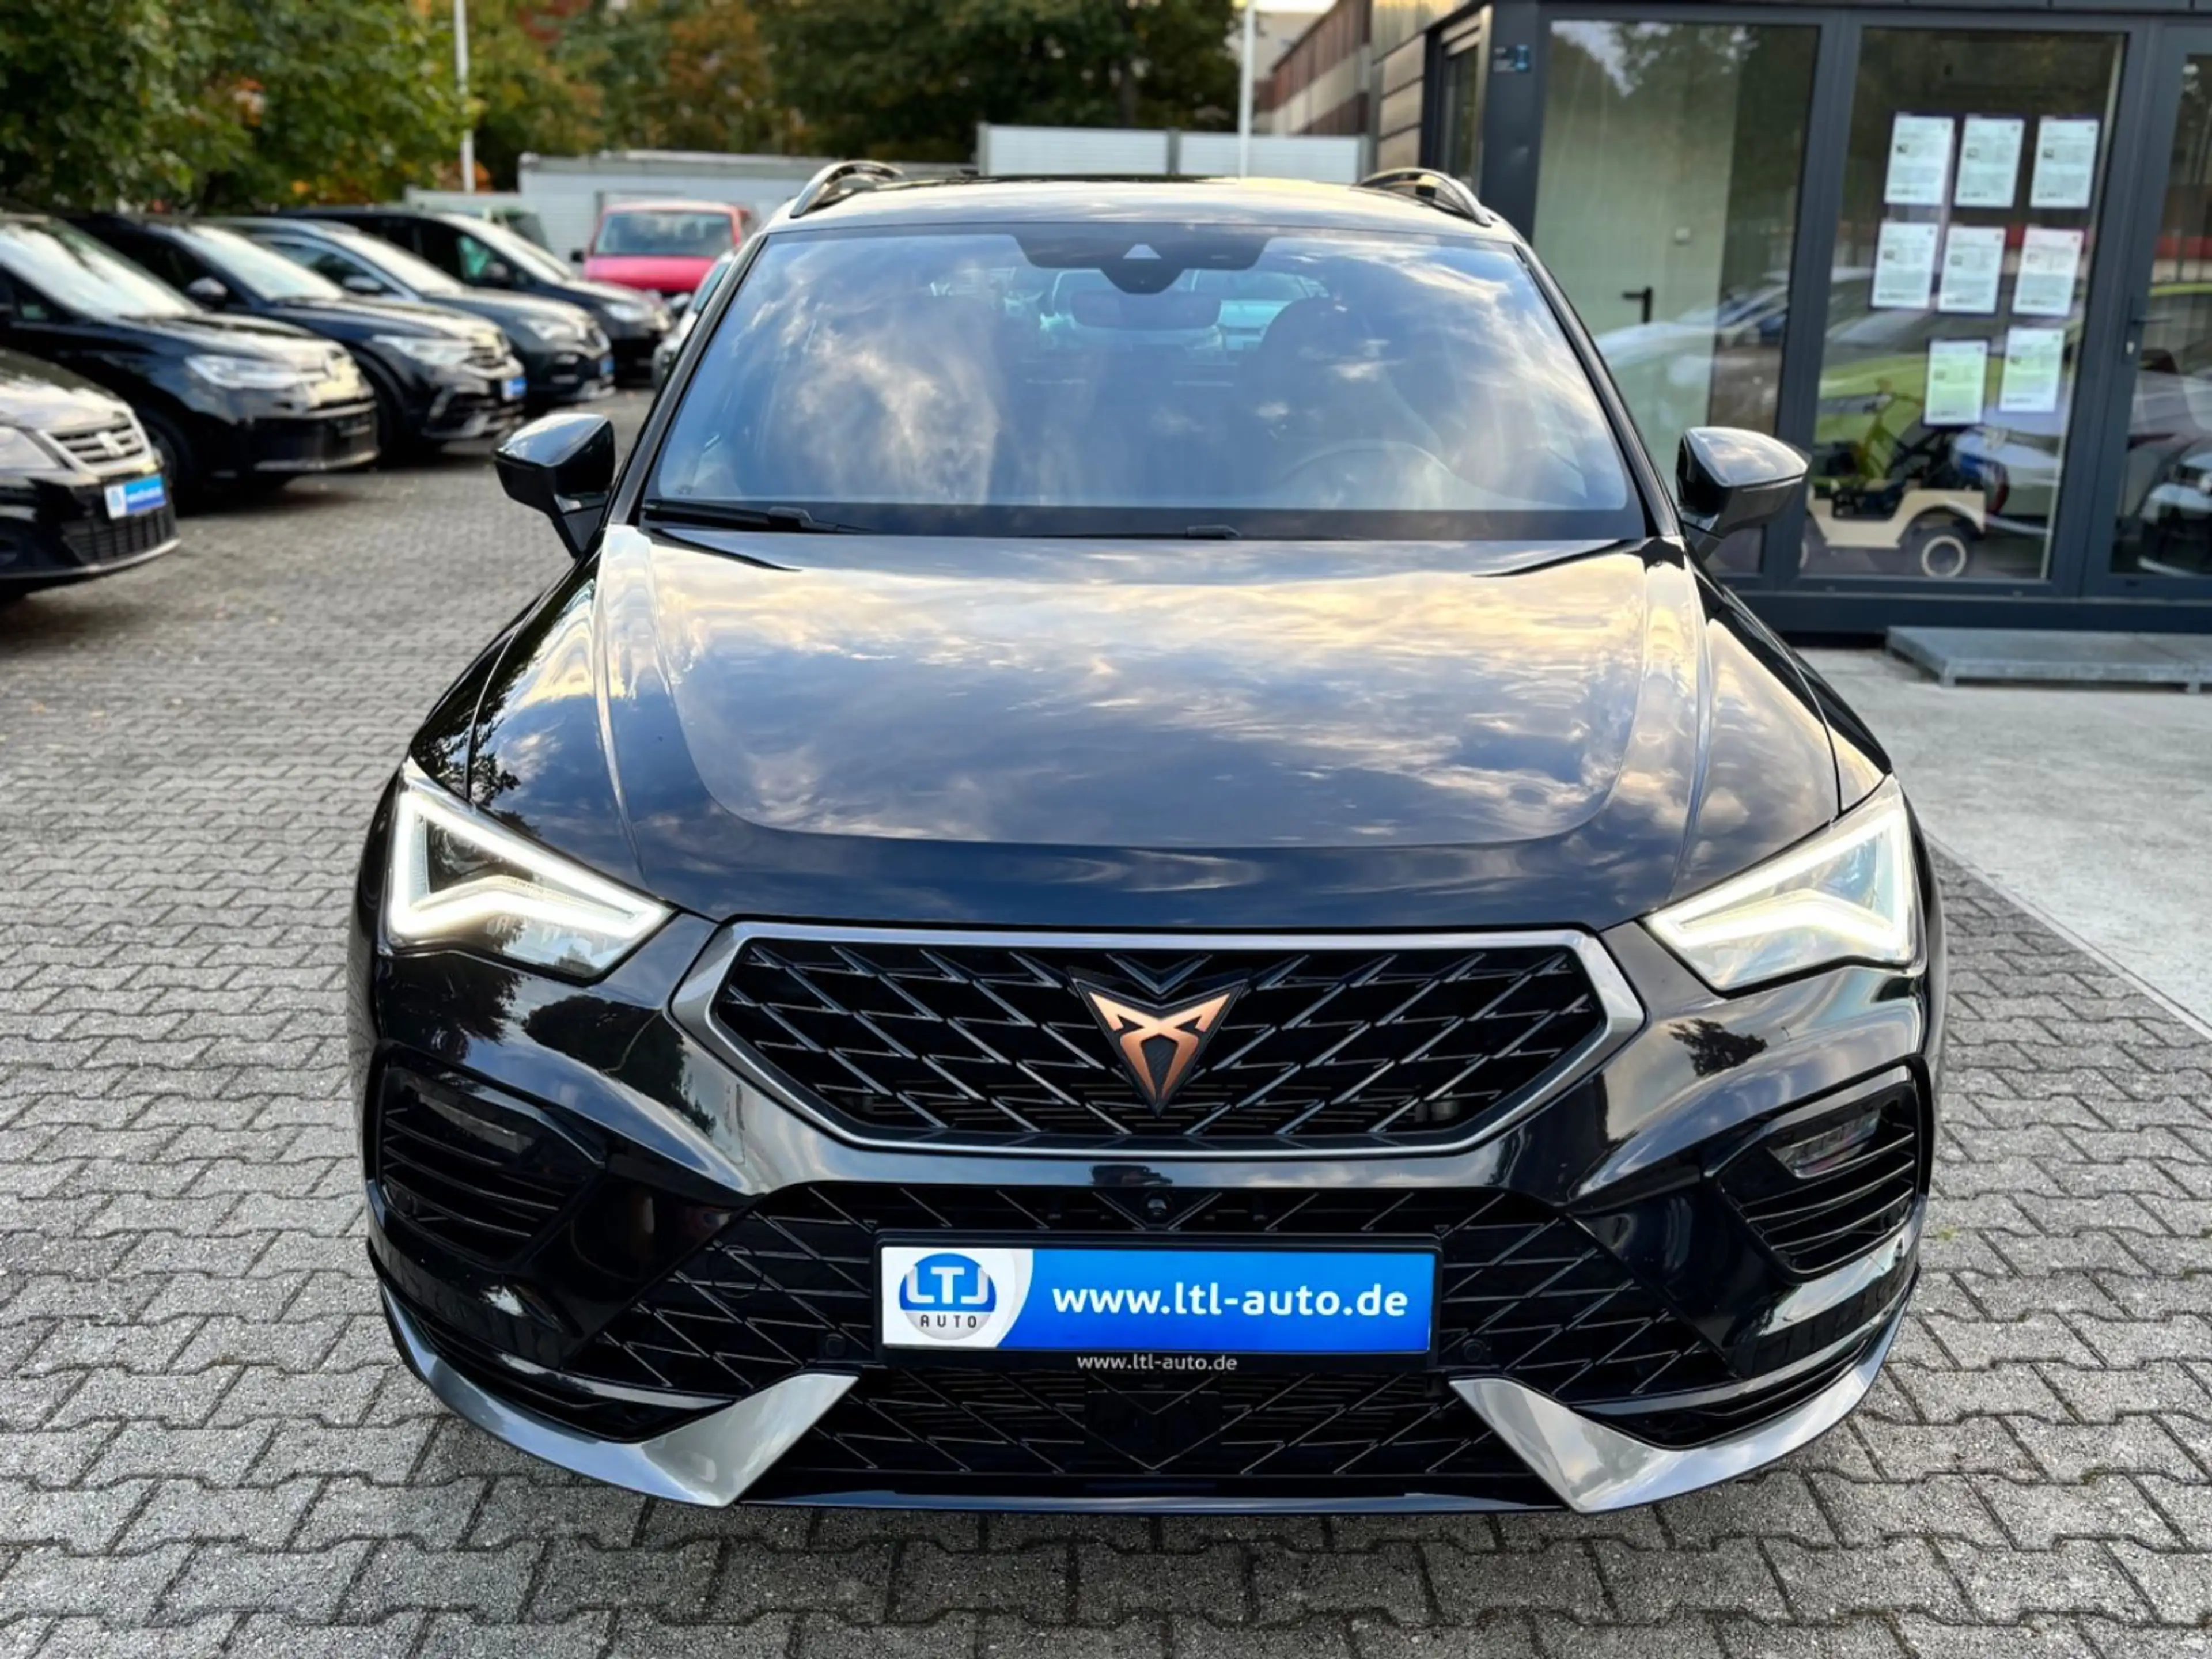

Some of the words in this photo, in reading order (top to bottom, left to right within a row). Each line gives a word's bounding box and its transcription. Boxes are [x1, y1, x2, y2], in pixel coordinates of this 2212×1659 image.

[1052, 1282, 1408, 1316] www.ltl-auto.de
[920, 1314, 977, 1328] AUTO
[1077, 1354, 1238, 1370] www.ltl-auto.de
